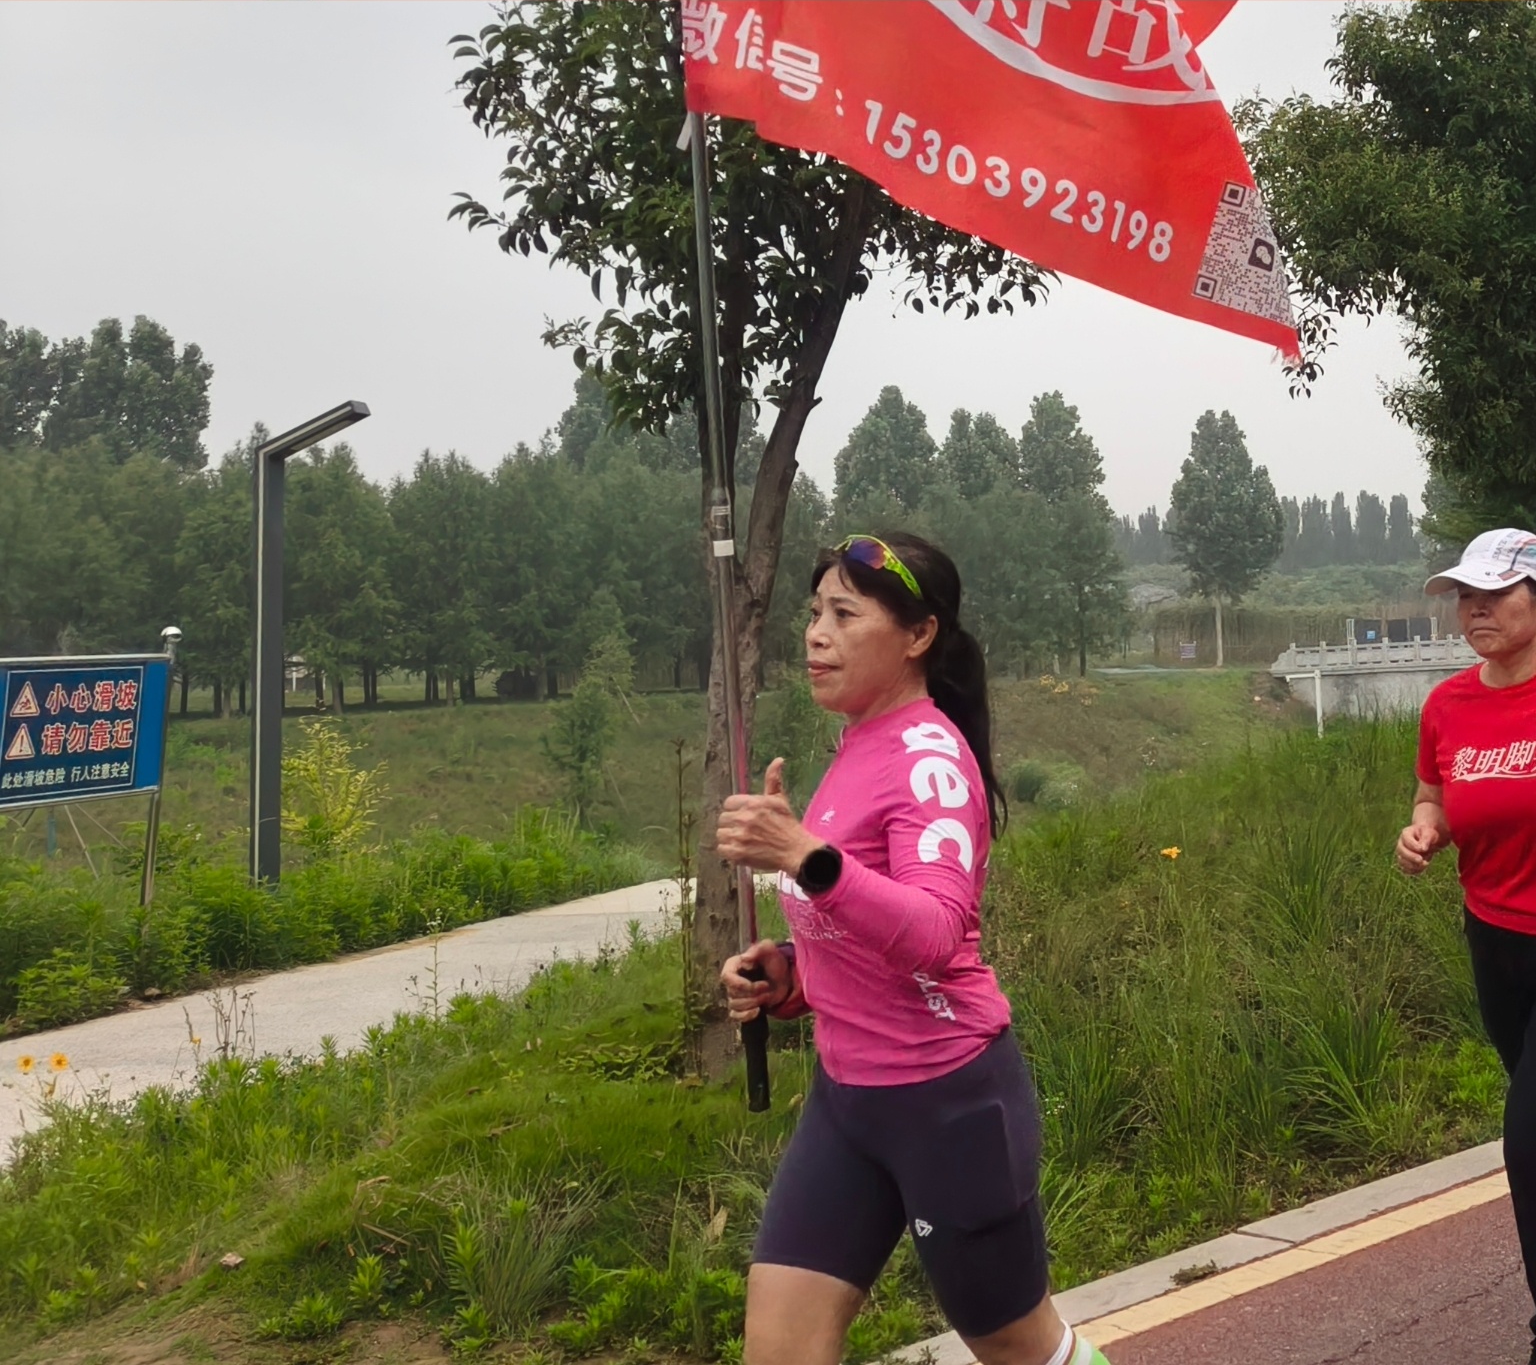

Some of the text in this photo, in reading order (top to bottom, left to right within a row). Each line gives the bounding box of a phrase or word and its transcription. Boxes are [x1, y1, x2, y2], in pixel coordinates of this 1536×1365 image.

[45, 680, 138, 715] 小心滑坡
[41, 720, 134, 756] 请勿靠近
[1, 762, 130, 790] 此处滑坡危险 行人注意安全
